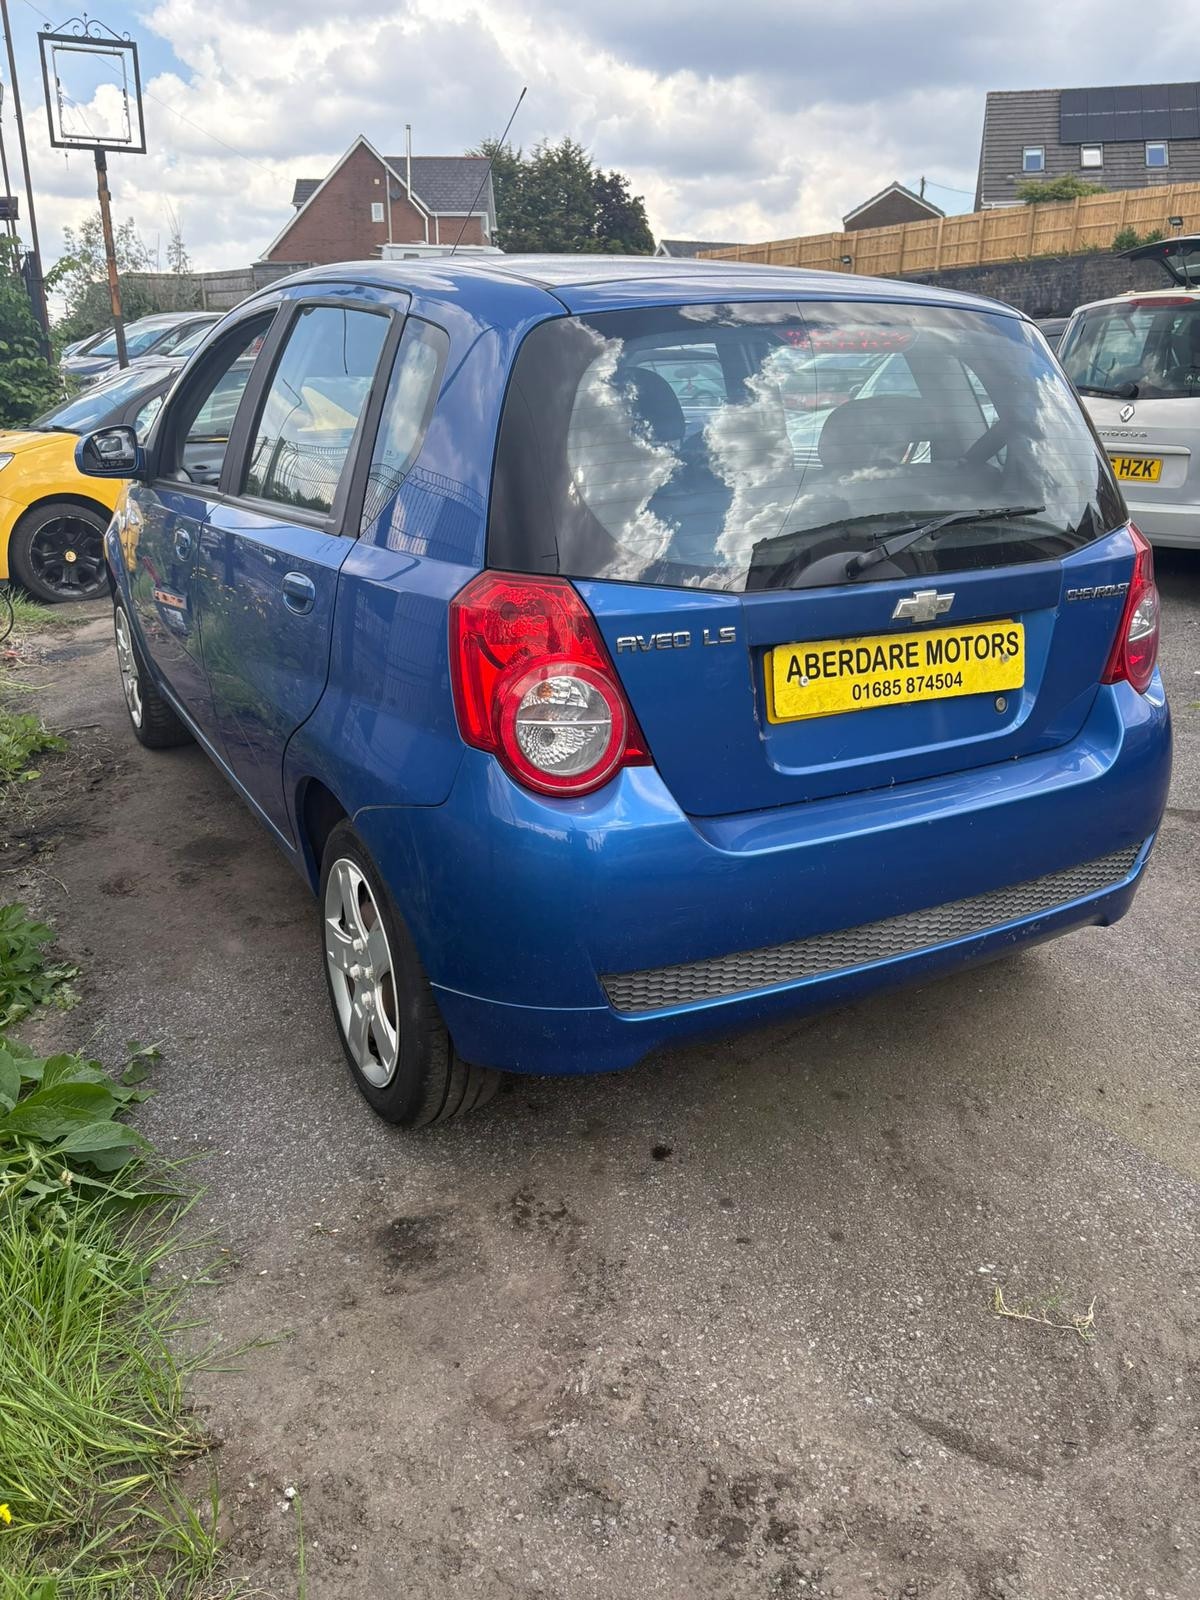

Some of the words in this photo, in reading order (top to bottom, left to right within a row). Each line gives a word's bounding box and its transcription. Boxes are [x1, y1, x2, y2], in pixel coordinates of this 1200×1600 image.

[1119, 458, 1155, 478] HZK
[1066, 582, 1130, 601] CHEVROLET
[616, 631, 691, 654] AVEO
[703, 626, 736, 646] LS
[786, 641, 919, 683] ABERDARE
[926, 631, 1019, 666] MOTORS
[852, 679, 901, 701] 01685
[906, 671, 963, 694] 874504
